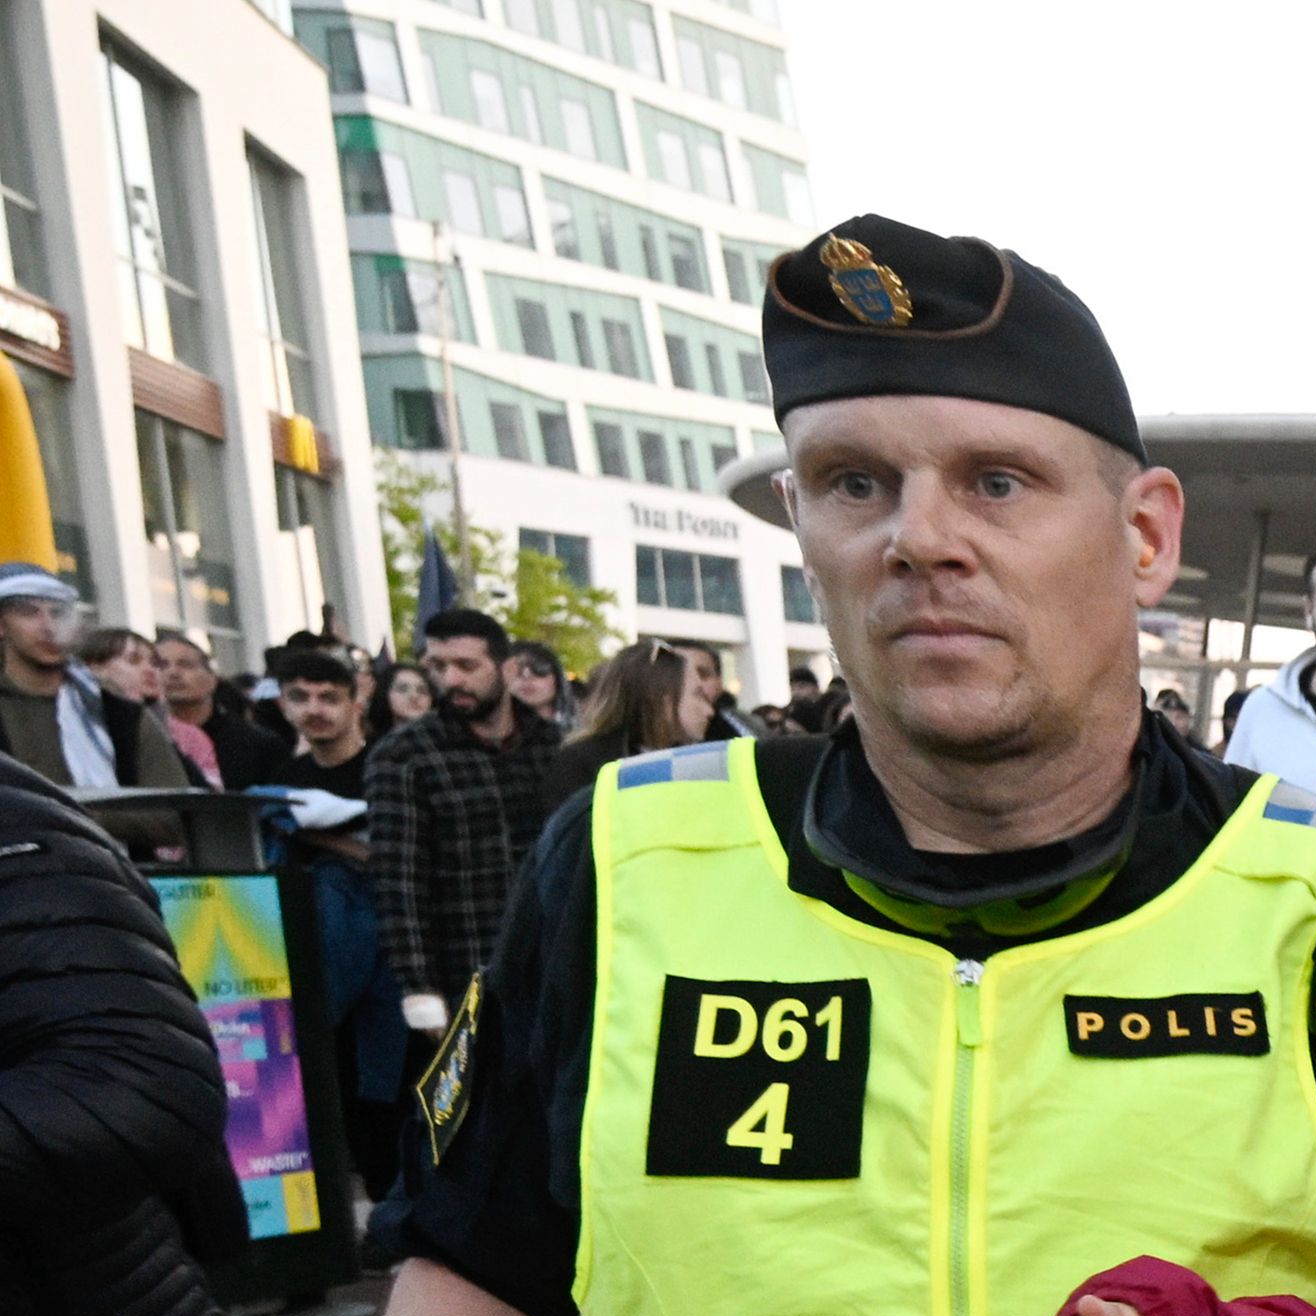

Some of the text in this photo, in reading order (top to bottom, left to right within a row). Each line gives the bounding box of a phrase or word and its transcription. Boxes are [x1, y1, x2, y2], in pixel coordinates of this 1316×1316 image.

[694, 994, 842, 1062] D61
[1077, 1007, 1257, 1041] POLIS
[726, 1082, 793, 1165] 4
